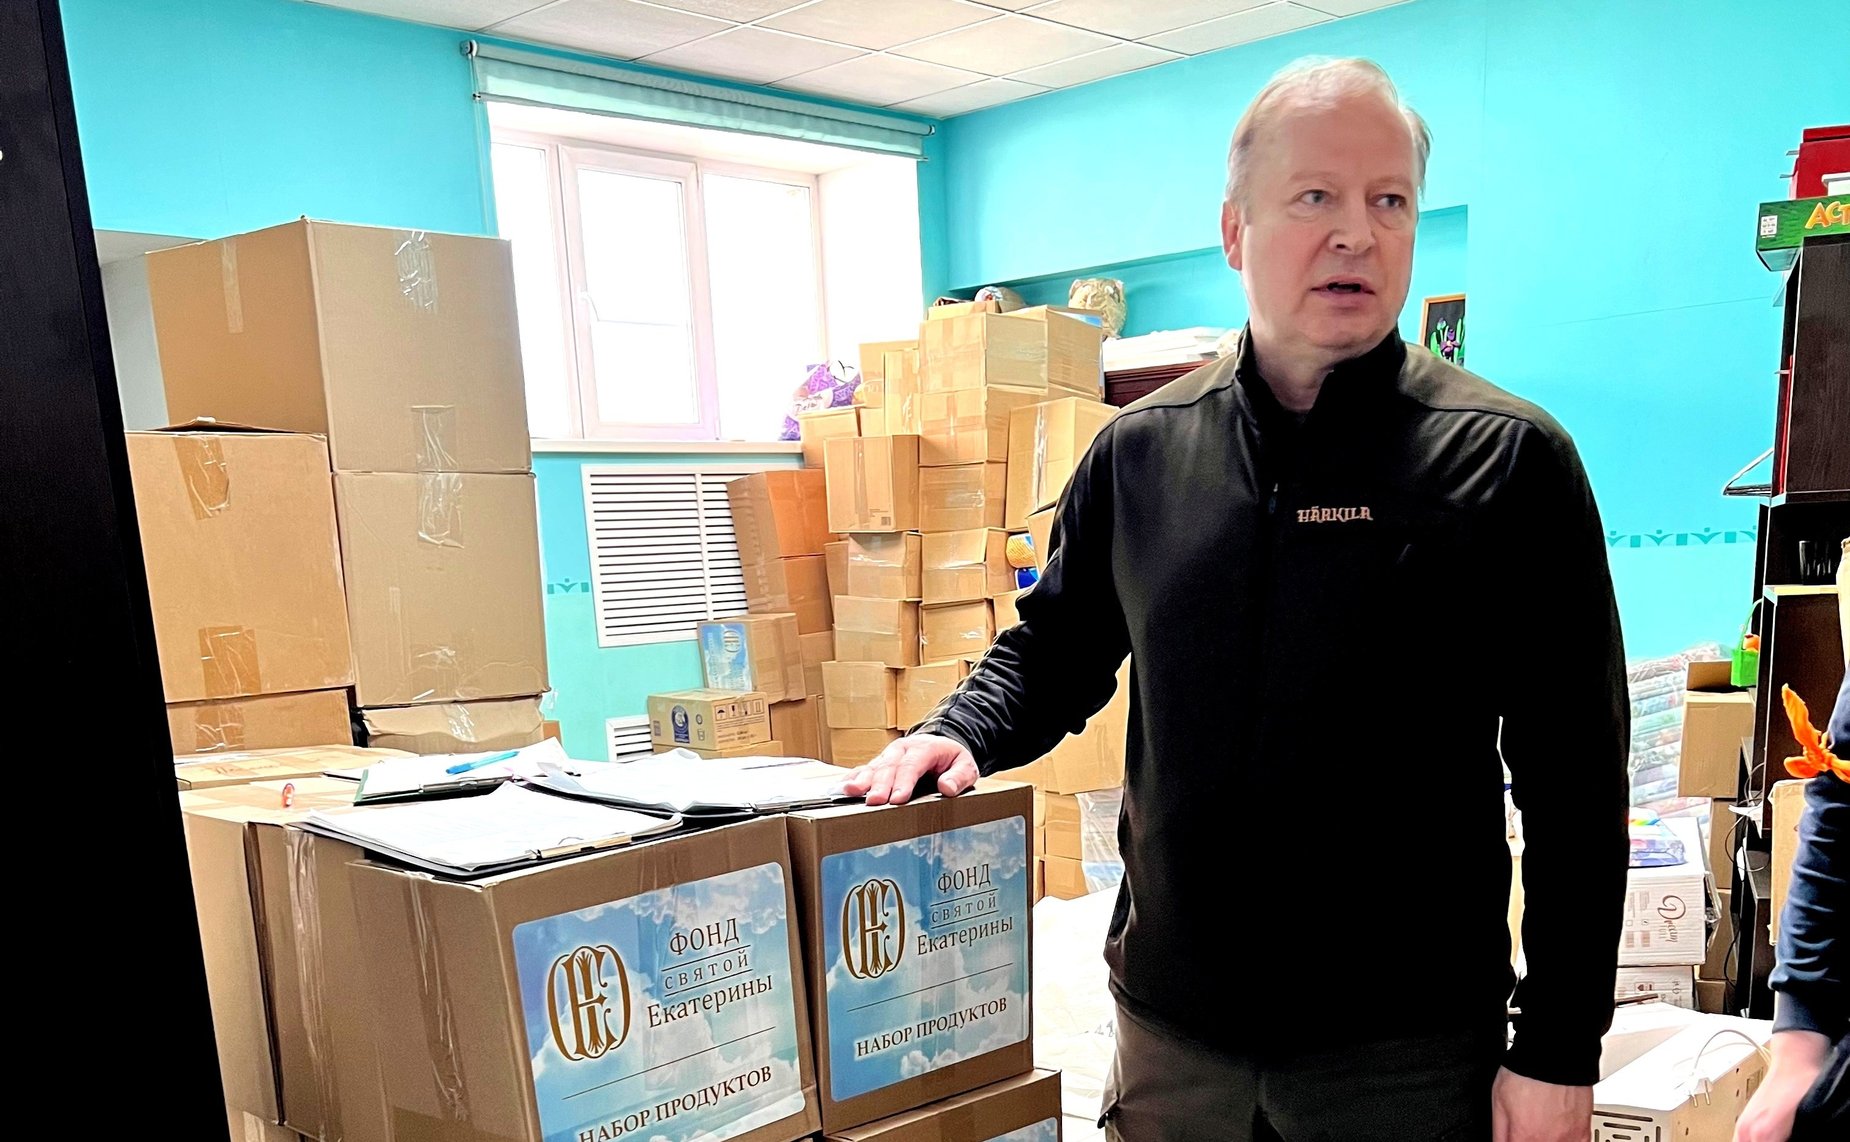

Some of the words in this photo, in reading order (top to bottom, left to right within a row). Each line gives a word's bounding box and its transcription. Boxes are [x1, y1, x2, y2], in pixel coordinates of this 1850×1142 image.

[937, 863, 991, 894] ФОНД
[669, 918, 740, 955] ФОНД
[917, 916, 1013, 956] Екатерины
[647, 975, 773, 1028] Екатерины
[856, 1027, 913, 1057] НАБОР
[916, 997, 1008, 1038] ПРОДУКТОВ
[579, 1109, 650, 1142] НАБОР
[655, 1065, 772, 1122] ПРОДУКТОВ
